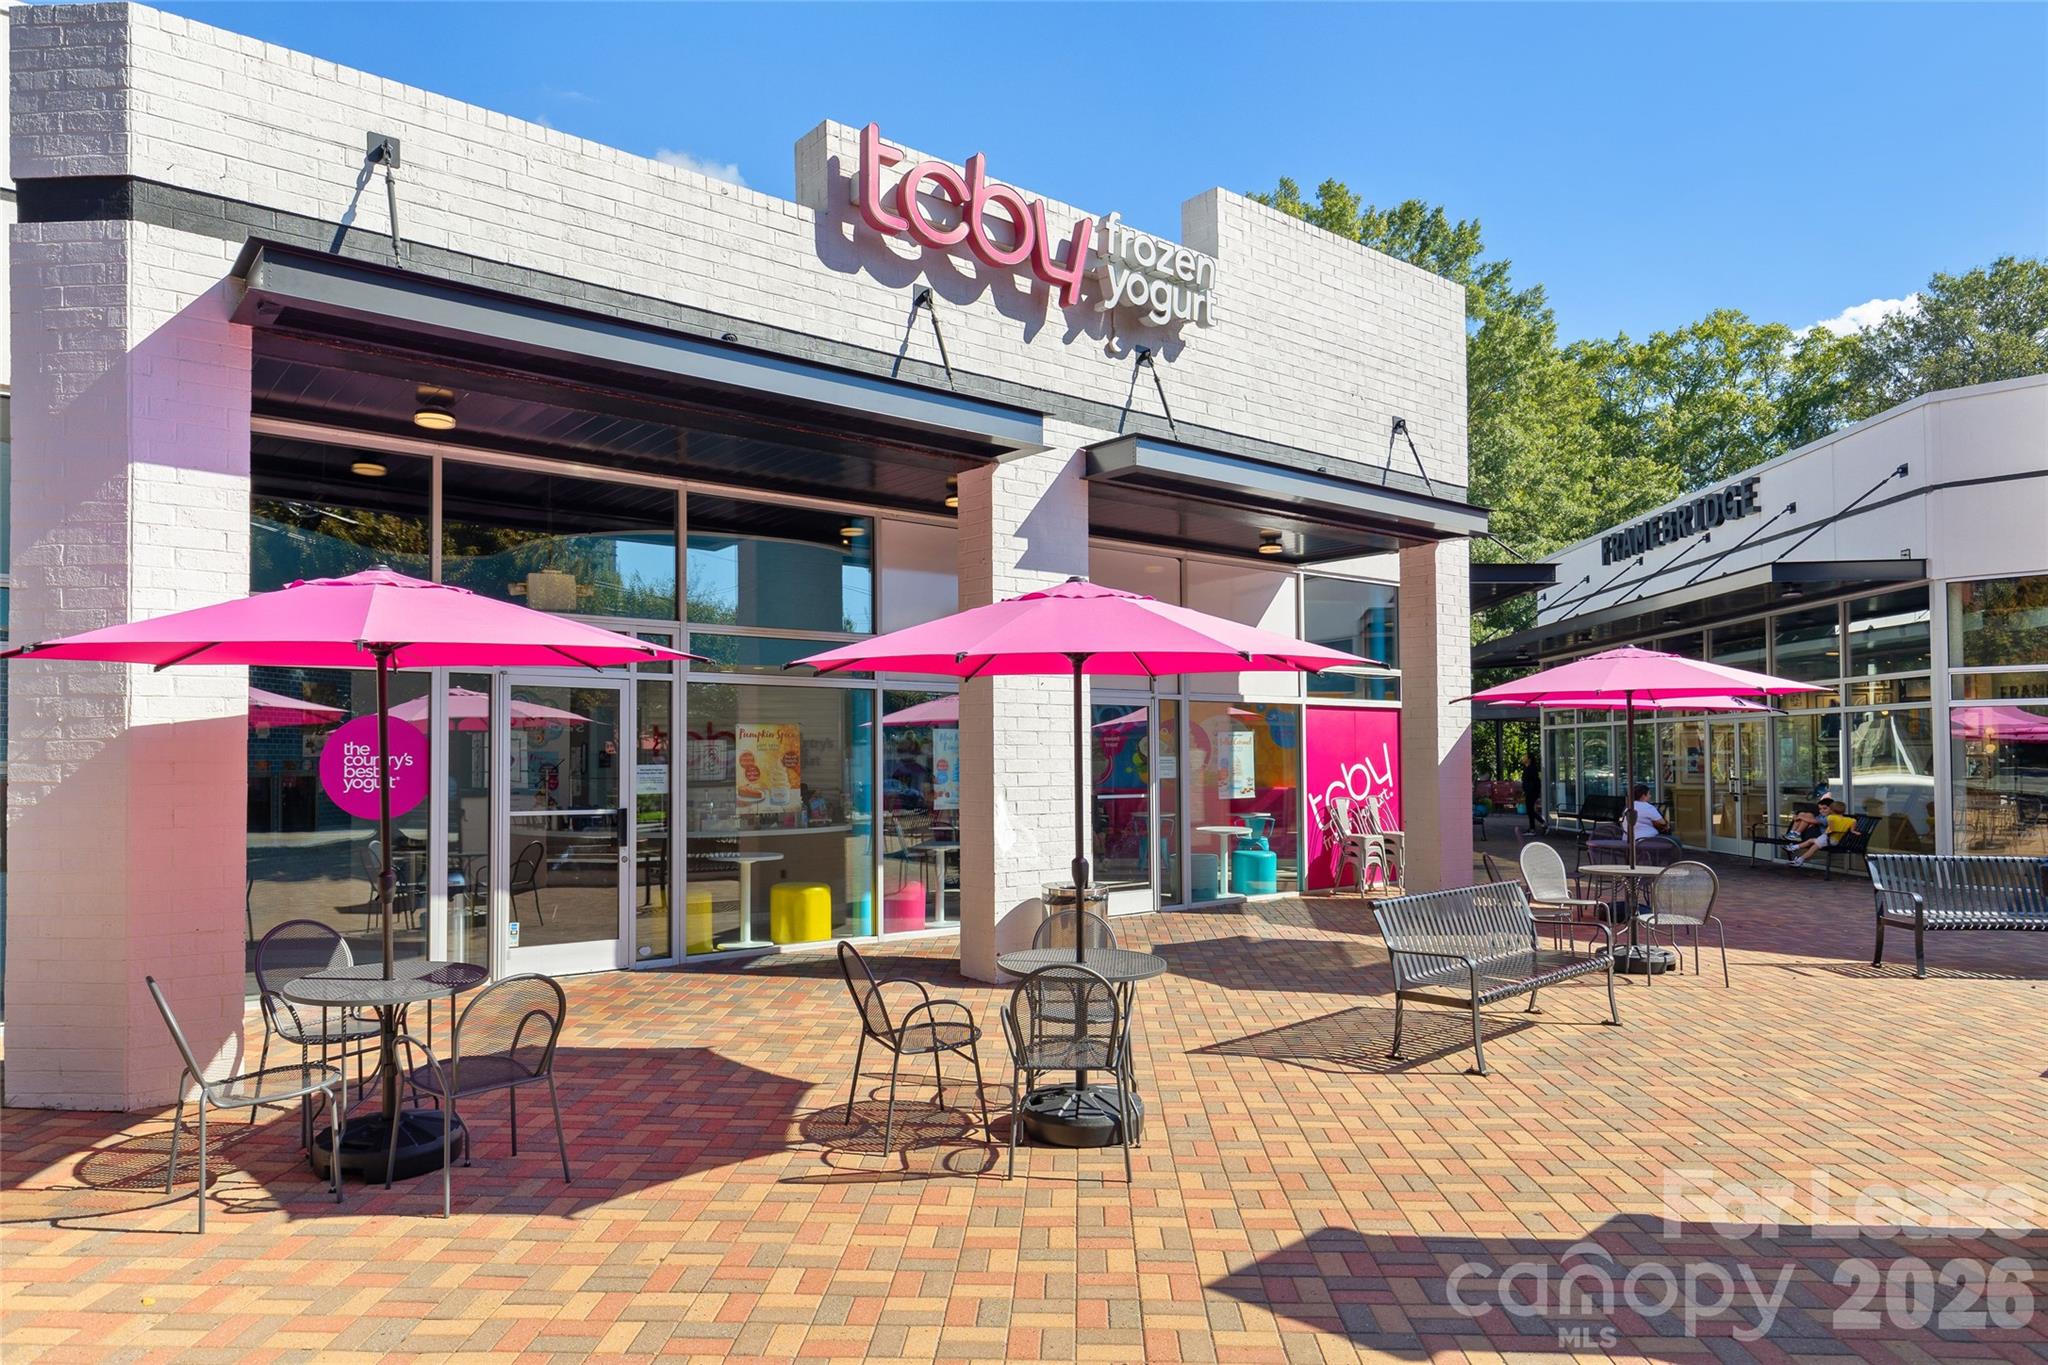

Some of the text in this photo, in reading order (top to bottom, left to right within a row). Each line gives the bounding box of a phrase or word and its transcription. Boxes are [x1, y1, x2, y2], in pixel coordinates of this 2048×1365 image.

[860, 121, 1093, 308] tcby
[1101, 211, 1217, 290] frozen
[1103, 264, 1218, 325] yogurt
[1601, 477, 1761, 566] FRAMEBRIDGE
[739, 728, 775, 743] Pumpkin
[344, 742, 370, 755] the
[344, 753, 413, 770] counry's
[344, 766, 379, 778] best
[343, 776, 396, 793] yogut
